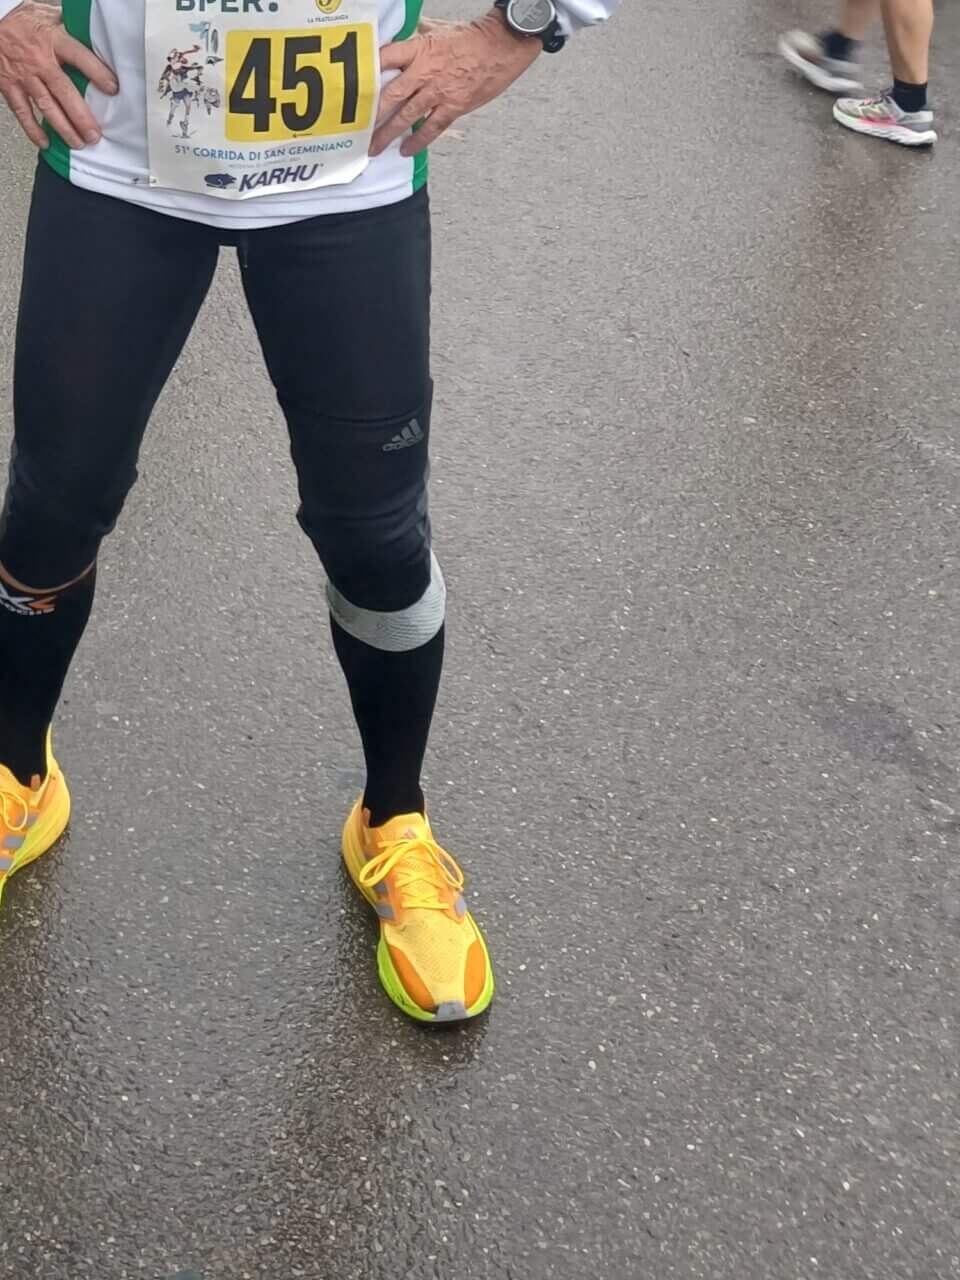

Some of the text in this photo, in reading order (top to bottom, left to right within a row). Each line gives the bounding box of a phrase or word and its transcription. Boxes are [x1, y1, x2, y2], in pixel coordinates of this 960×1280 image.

[228, 31, 359, 133] 451
[193, 147, 244, 161] CORRIDA
[249, 150, 261, 161] DI
[264, 147, 286, 160] SAN
[288, 139, 353, 156] GEMINIANO
[239, 163, 319, 192] KARHU
